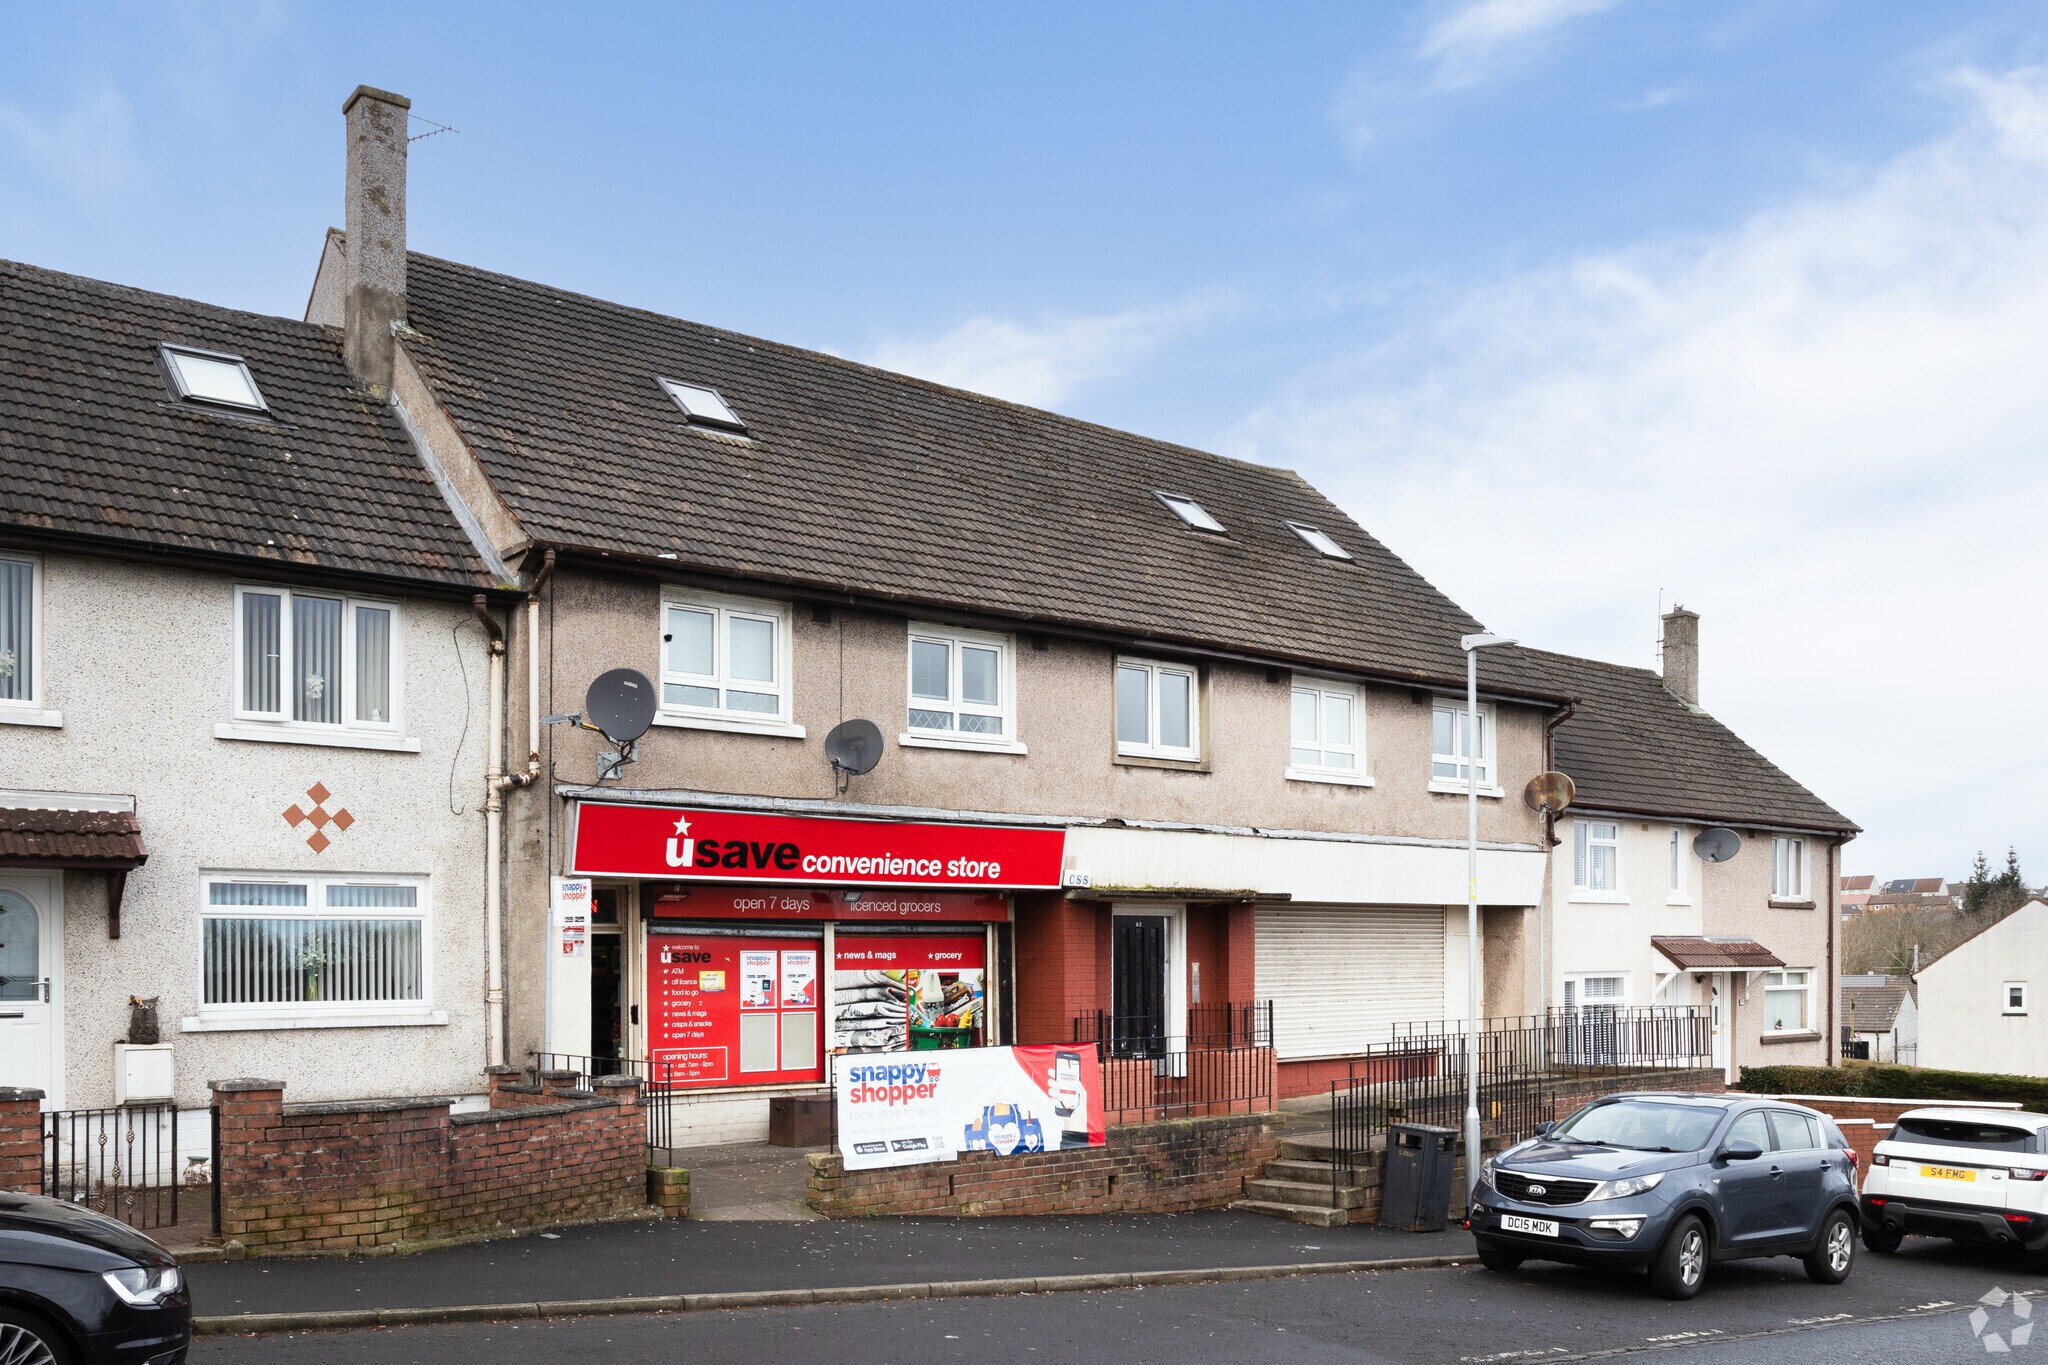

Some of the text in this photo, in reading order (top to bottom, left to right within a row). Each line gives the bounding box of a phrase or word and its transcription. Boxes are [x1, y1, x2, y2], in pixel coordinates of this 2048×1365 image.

[665, 837, 1001, 879] usave convenience store
[562, 883, 583, 892] snappy
[562, 892, 586, 901] shopper
[733, 896, 941, 914] open 7 days licenced grocers
[660, 952, 711, 964] usave
[866, 950, 874, 959] &
[874, 952, 897, 961] mags
[934, 952, 962, 961] grocery
[850, 1063, 927, 1085] snappy
[850, 1082, 938, 1106] shopper
[850, 1110, 875, 1120] Local
[879, 1108, 901, 1118] store
[904, 1108, 914, 1116] to
[1399, 1149, 1415, 1157] Litter
[1930, 1168, 1965, 1179] S4 FMG
[1529, 1186, 1542, 1194] KIA
[1508, 1217, 1552, 1233] DC15 MDK
